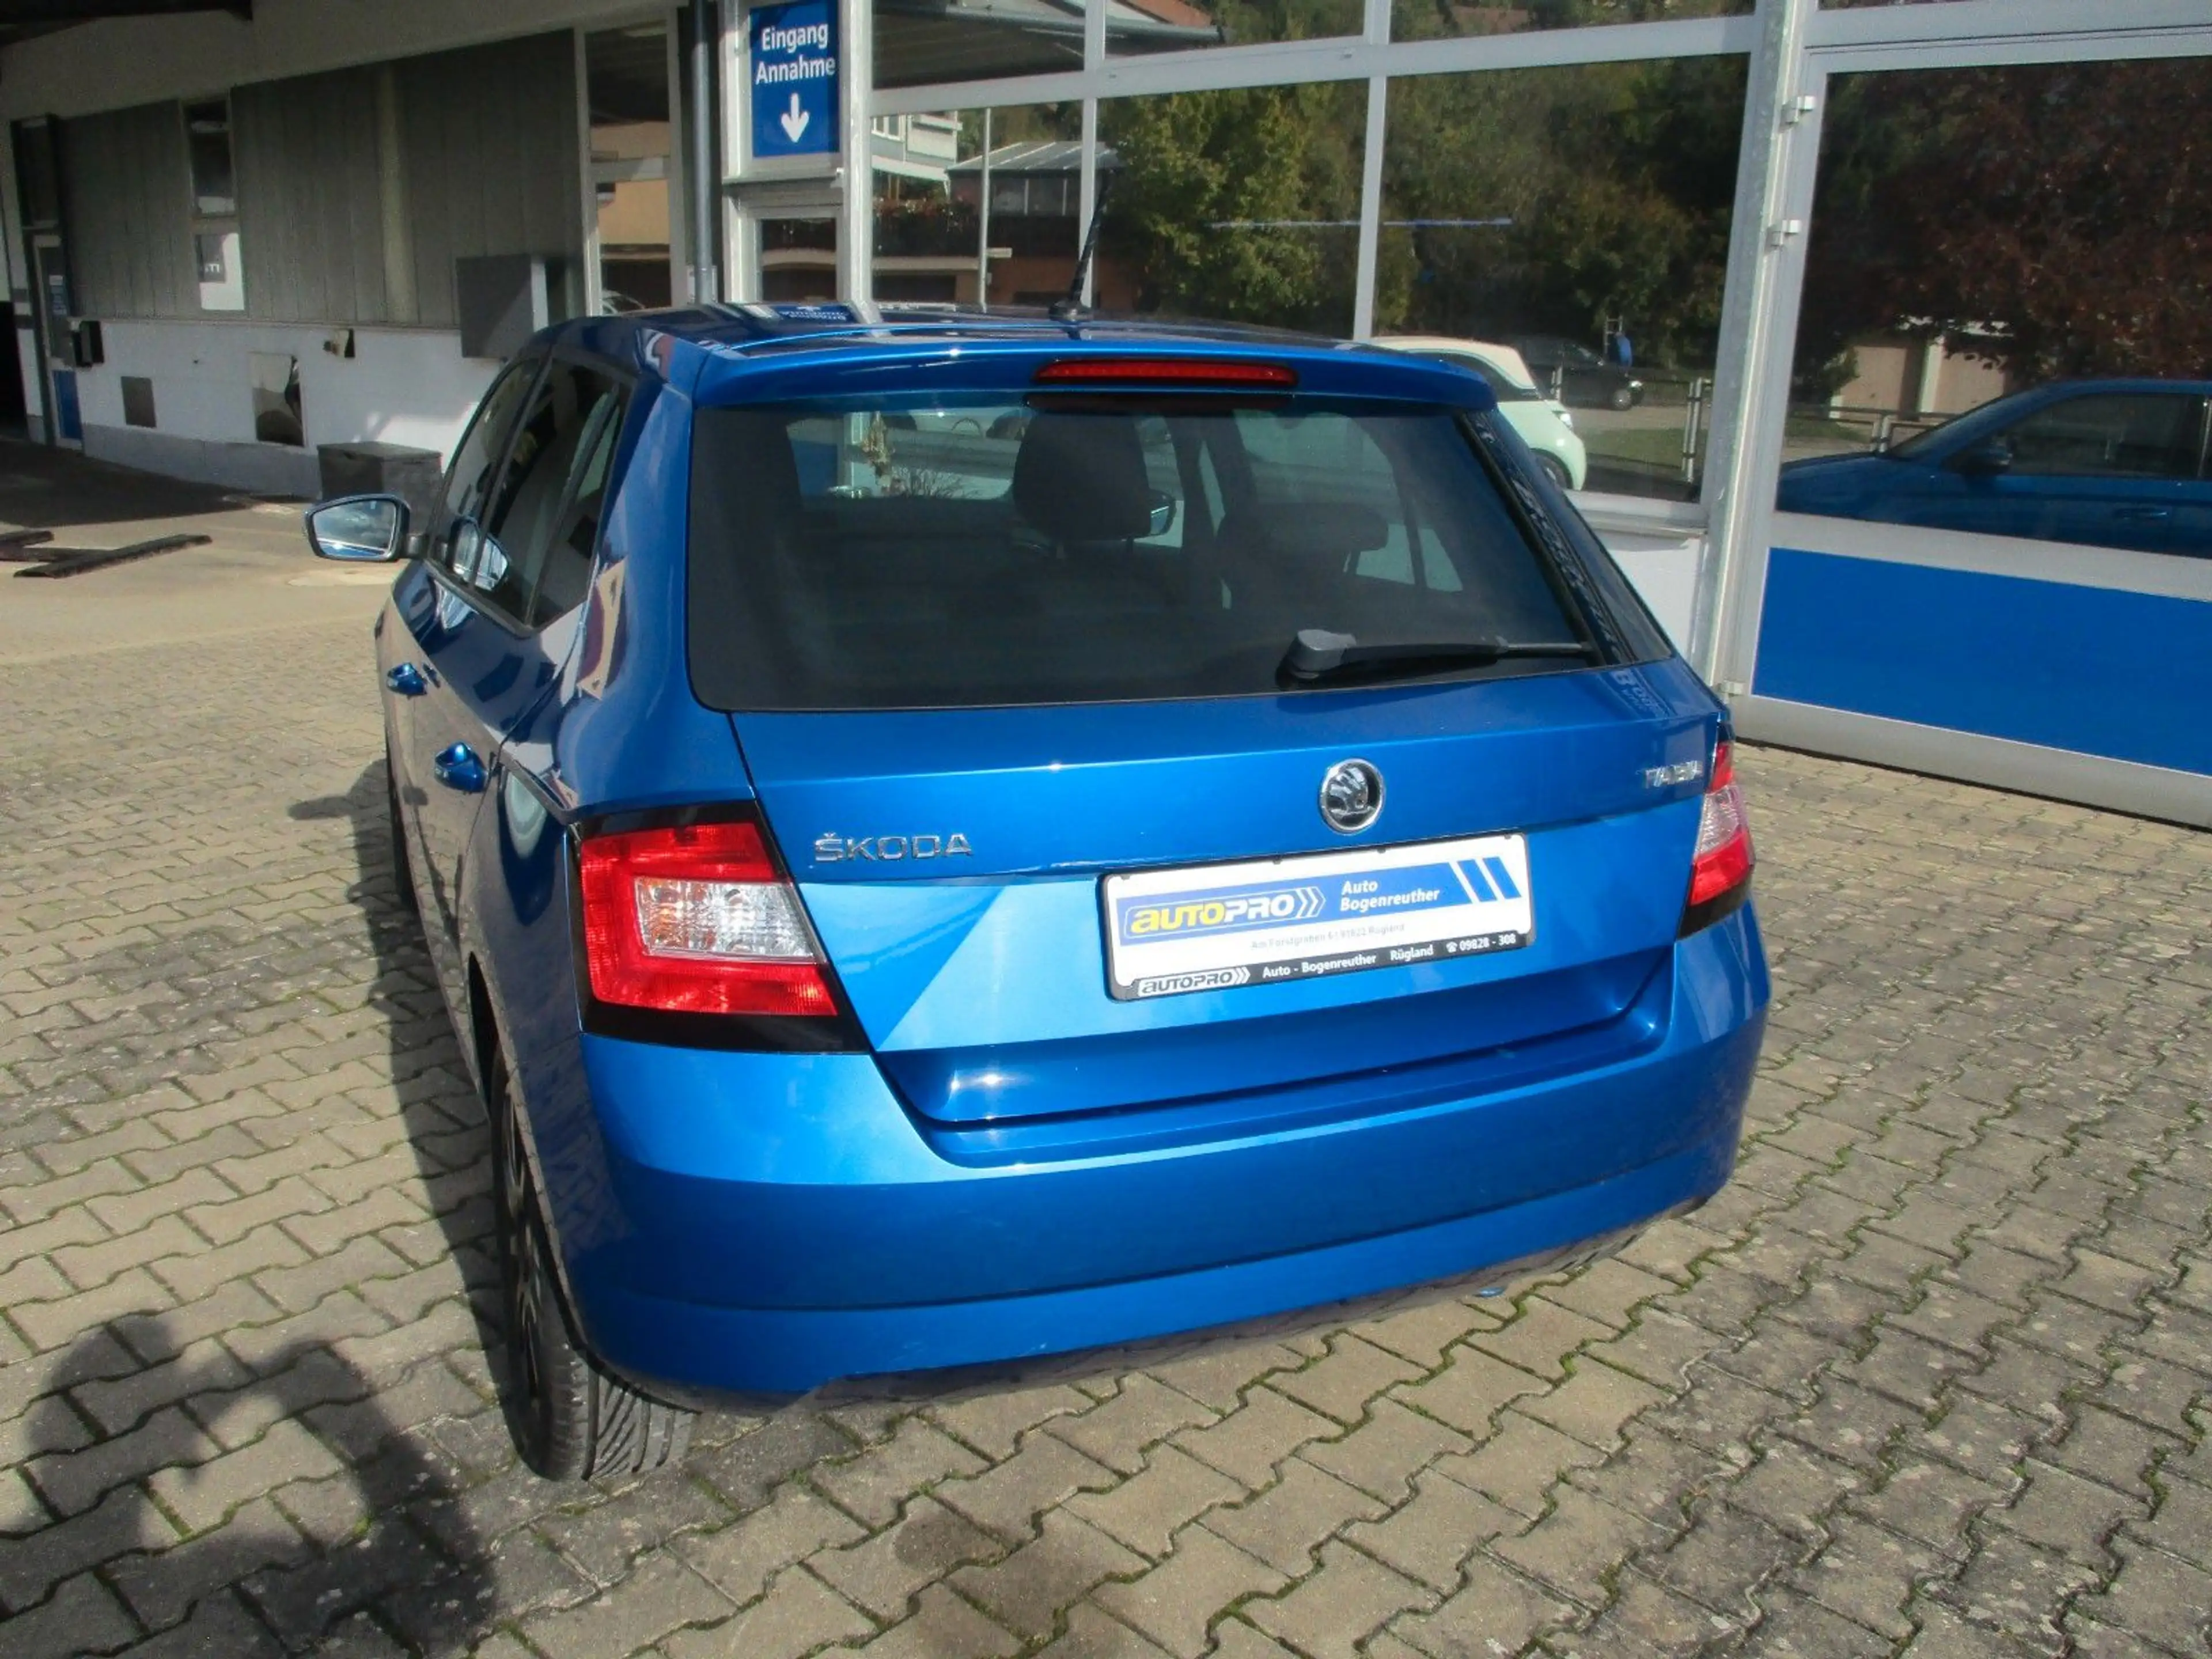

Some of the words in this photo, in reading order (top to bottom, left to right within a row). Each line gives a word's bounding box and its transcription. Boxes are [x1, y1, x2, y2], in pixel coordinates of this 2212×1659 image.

[762, 23, 829, 54] Eingang
[755, 54, 836, 85] Annahme
[815, 832, 972, 861] ŠKODA
[1340, 888, 1440, 913] Bogenreuther
[1341, 880, 1378, 896] Auto
[1263, 966, 1291, 979] Auto
[1301, 954, 1377, 975] Bogenreuther
[1389, 944, 1434, 962] Rügland
[1459, 937, 1490, 952] 09828
[1498, 933, 1517, 946] 308
